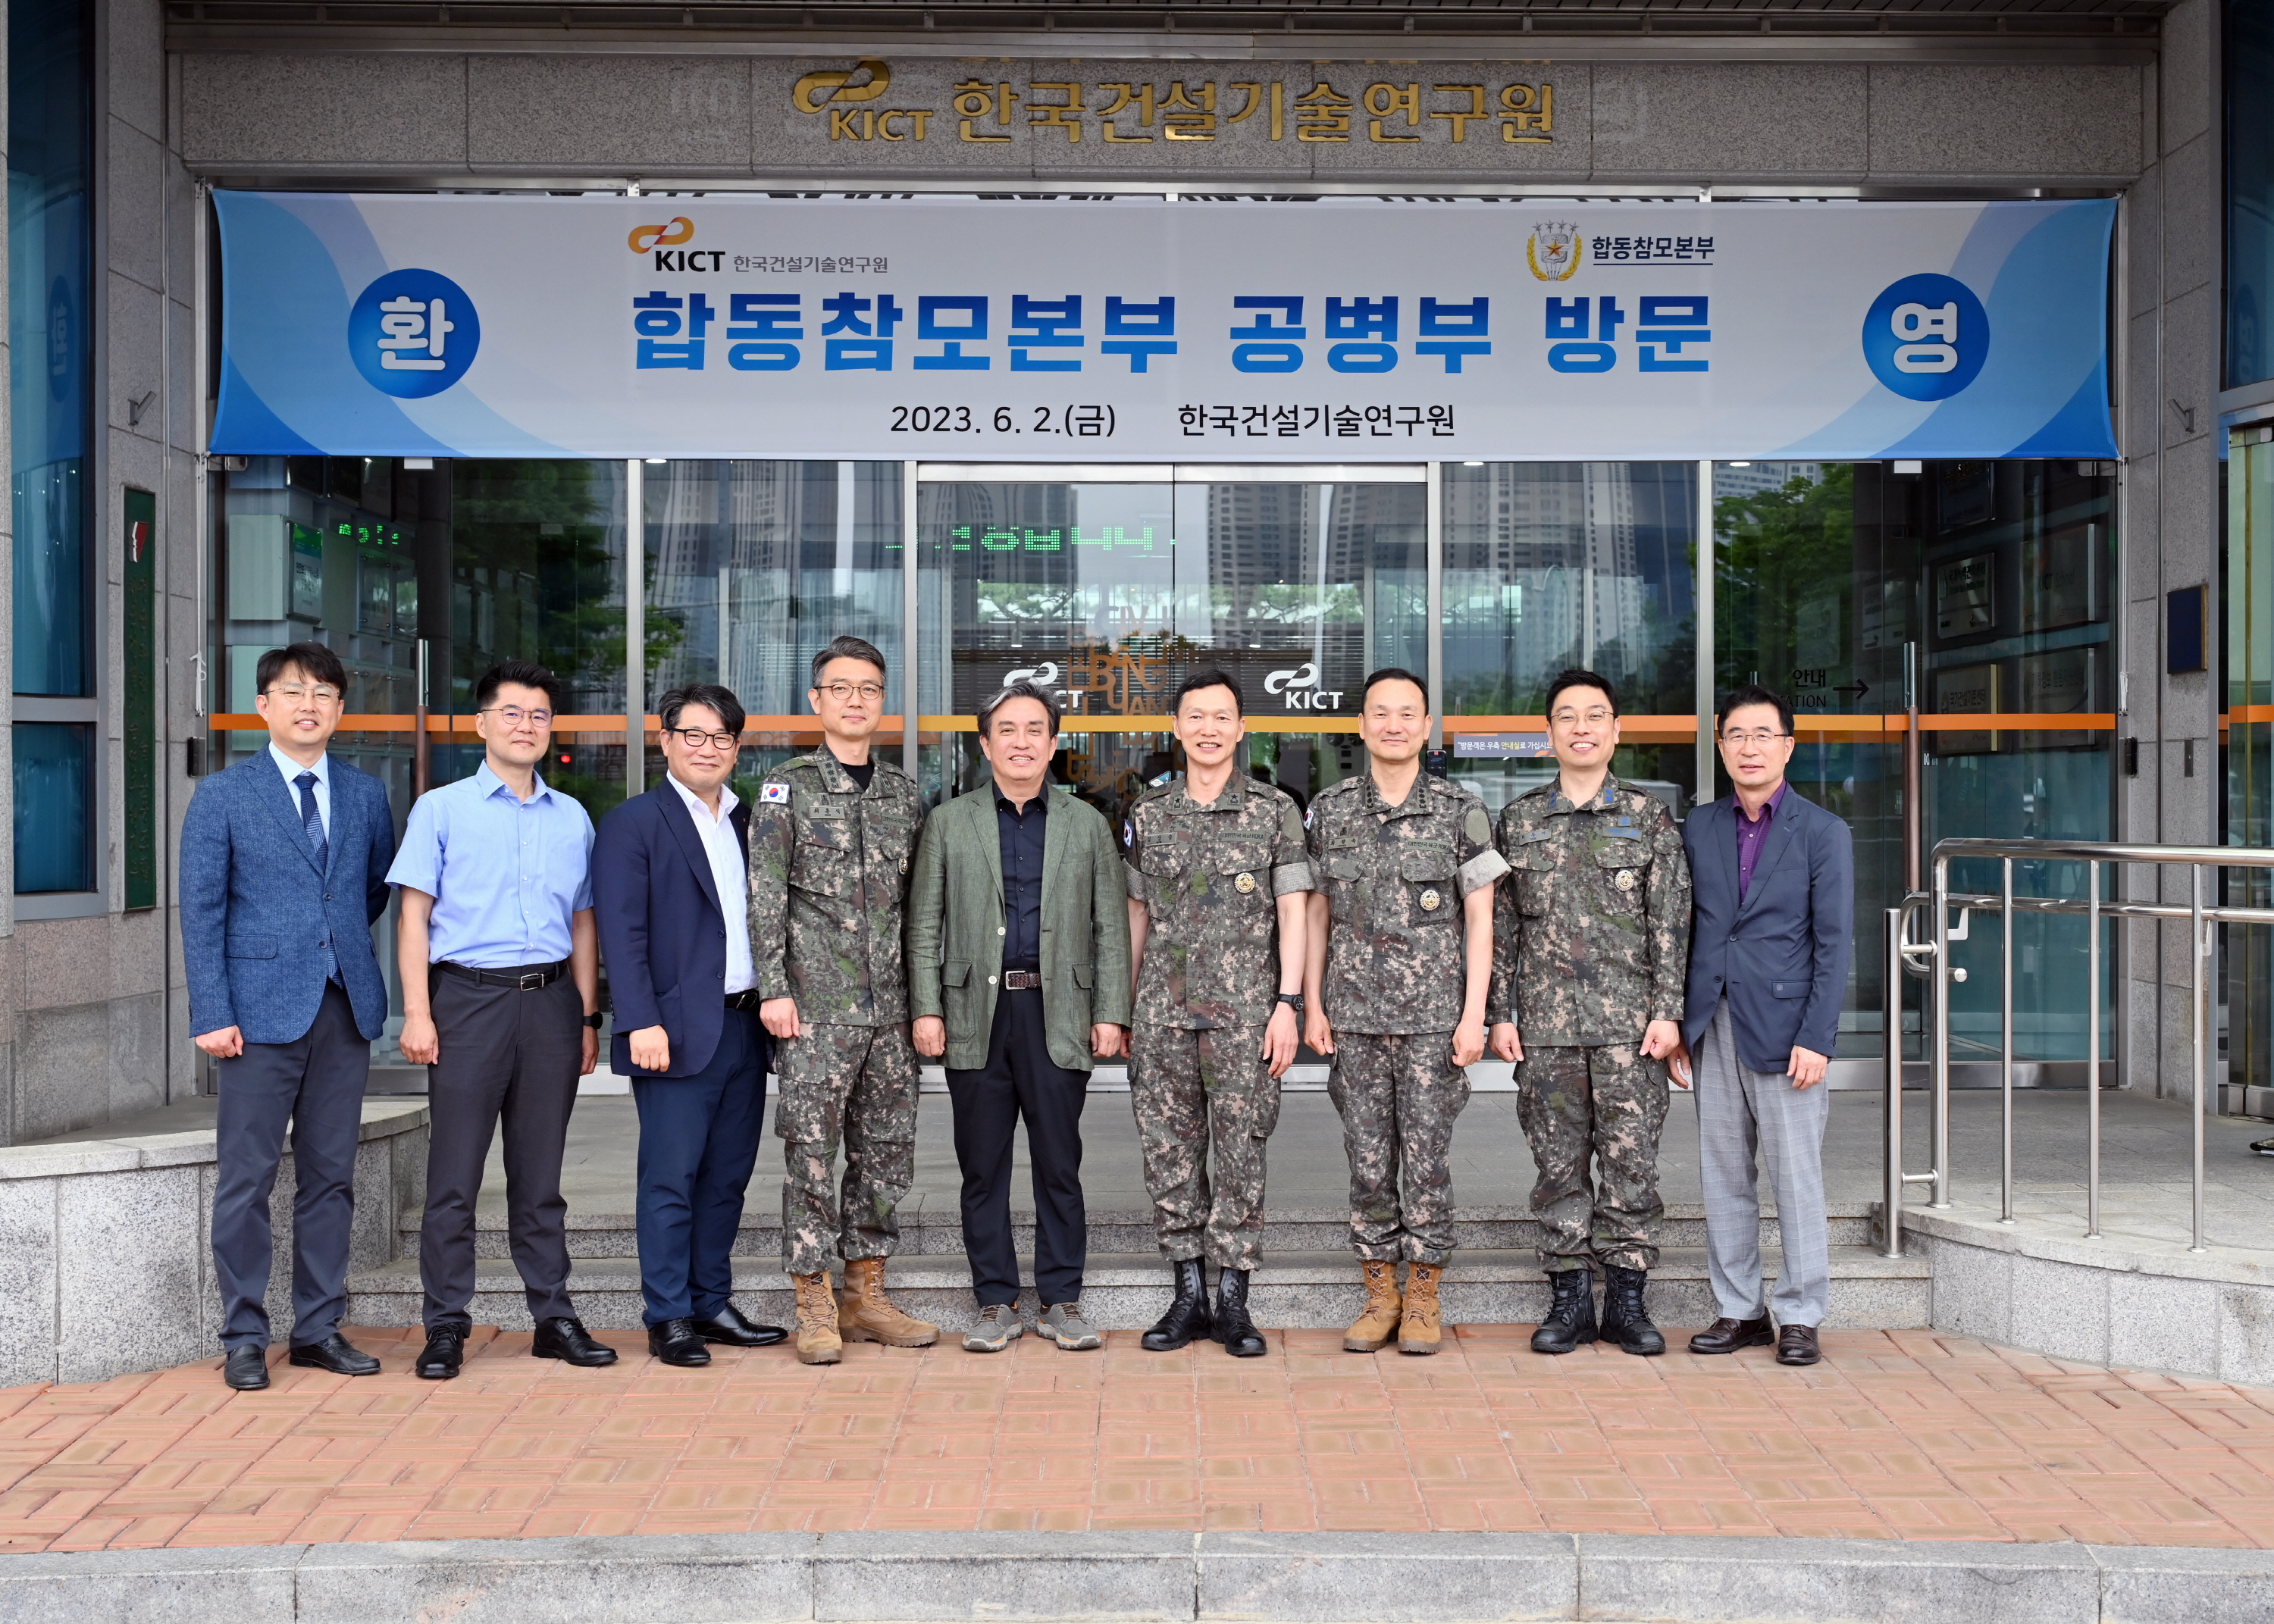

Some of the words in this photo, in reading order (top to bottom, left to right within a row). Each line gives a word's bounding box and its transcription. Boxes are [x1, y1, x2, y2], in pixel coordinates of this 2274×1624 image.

[830, 108, 933, 142] KICT
[953, 78, 1554, 144] 한국건설기술연구원
[1591, 236, 1715, 260] 합동참모본부
[655, 250, 725, 272] KICT
[733, 255, 888, 274] 한국건설기술연구원
[377, 296, 455, 371] 환
[633, 290, 1178, 374] 합동참모본부
[1229, 295, 1492, 374] 공병부
[1545, 296, 1711, 374] 방문
[1890, 301, 1958, 374] 영
[890, 405, 982, 435] 2023.
[993, 405, 1021, 435] 6.
[1032, 405, 1117, 437] 2.(금)
[1177, 403, 1455, 438] 한국건설기술연구원
[1792, 668, 1827, 688] 안내
[1057, 690, 1083, 709] CT
[1286, 691, 1343, 709] KICT
[1486, 741, 1500, 750] 우측
[1501, 741, 1527, 750] 안내실로
